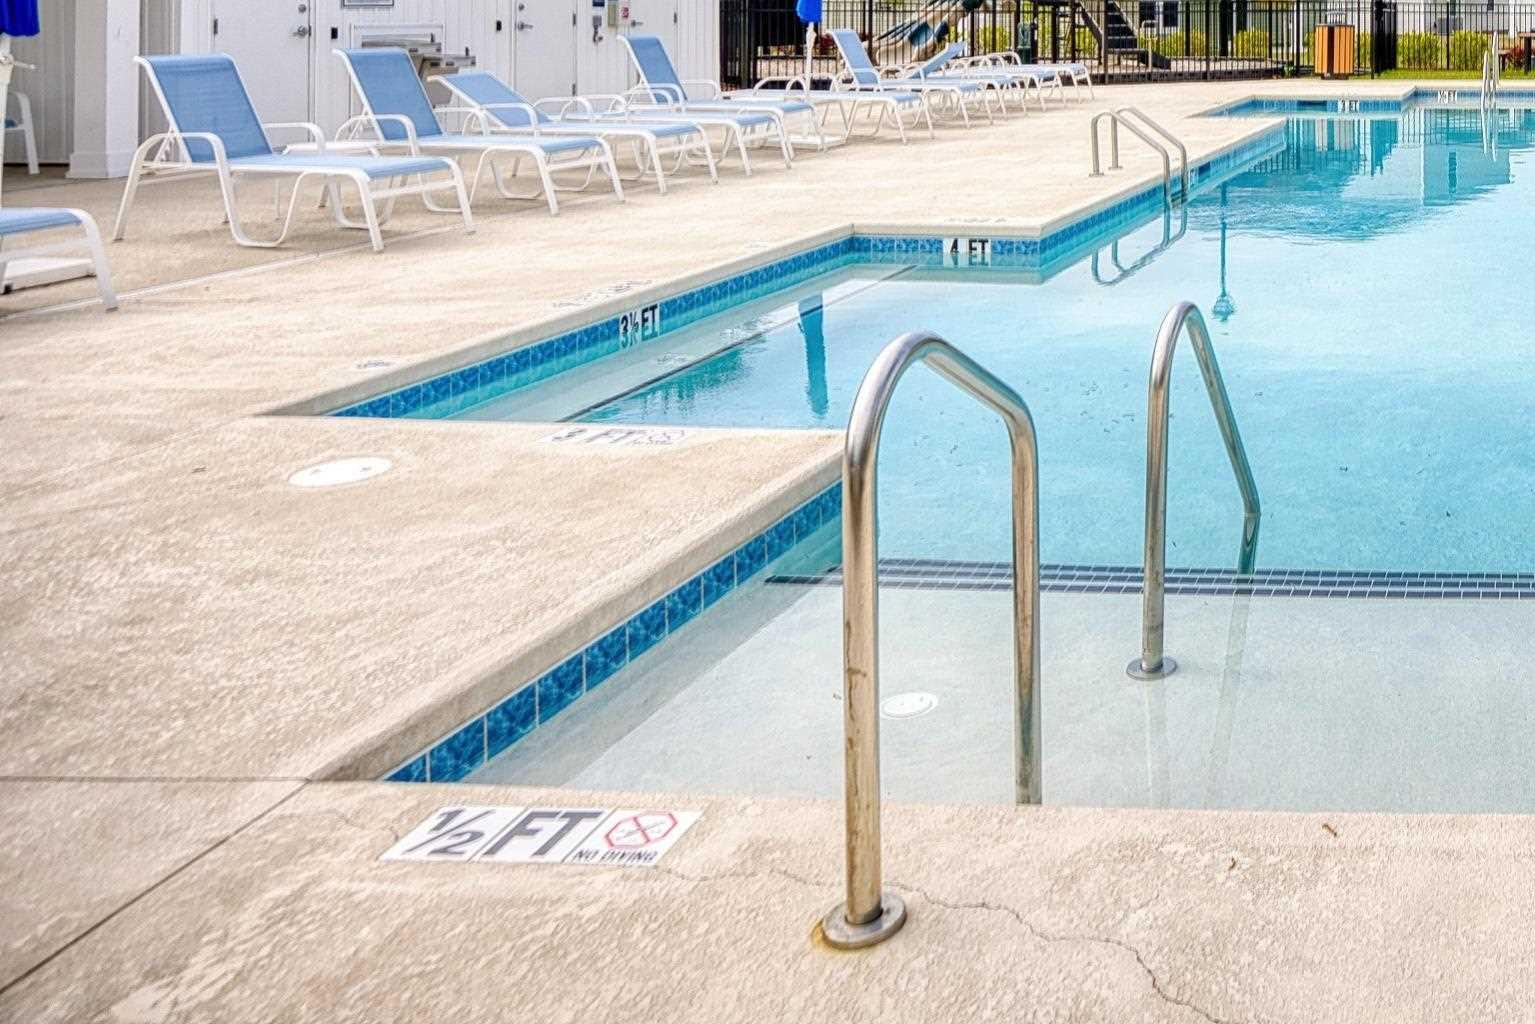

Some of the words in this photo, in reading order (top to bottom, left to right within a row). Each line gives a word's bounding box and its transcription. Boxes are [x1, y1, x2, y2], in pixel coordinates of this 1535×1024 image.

[969, 239, 988, 254] FT
[586, 429, 647, 443] FT
[483, 810, 604, 857] FT
[572, 849, 600, 863] NO
[600, 849, 658, 863] DIVING
